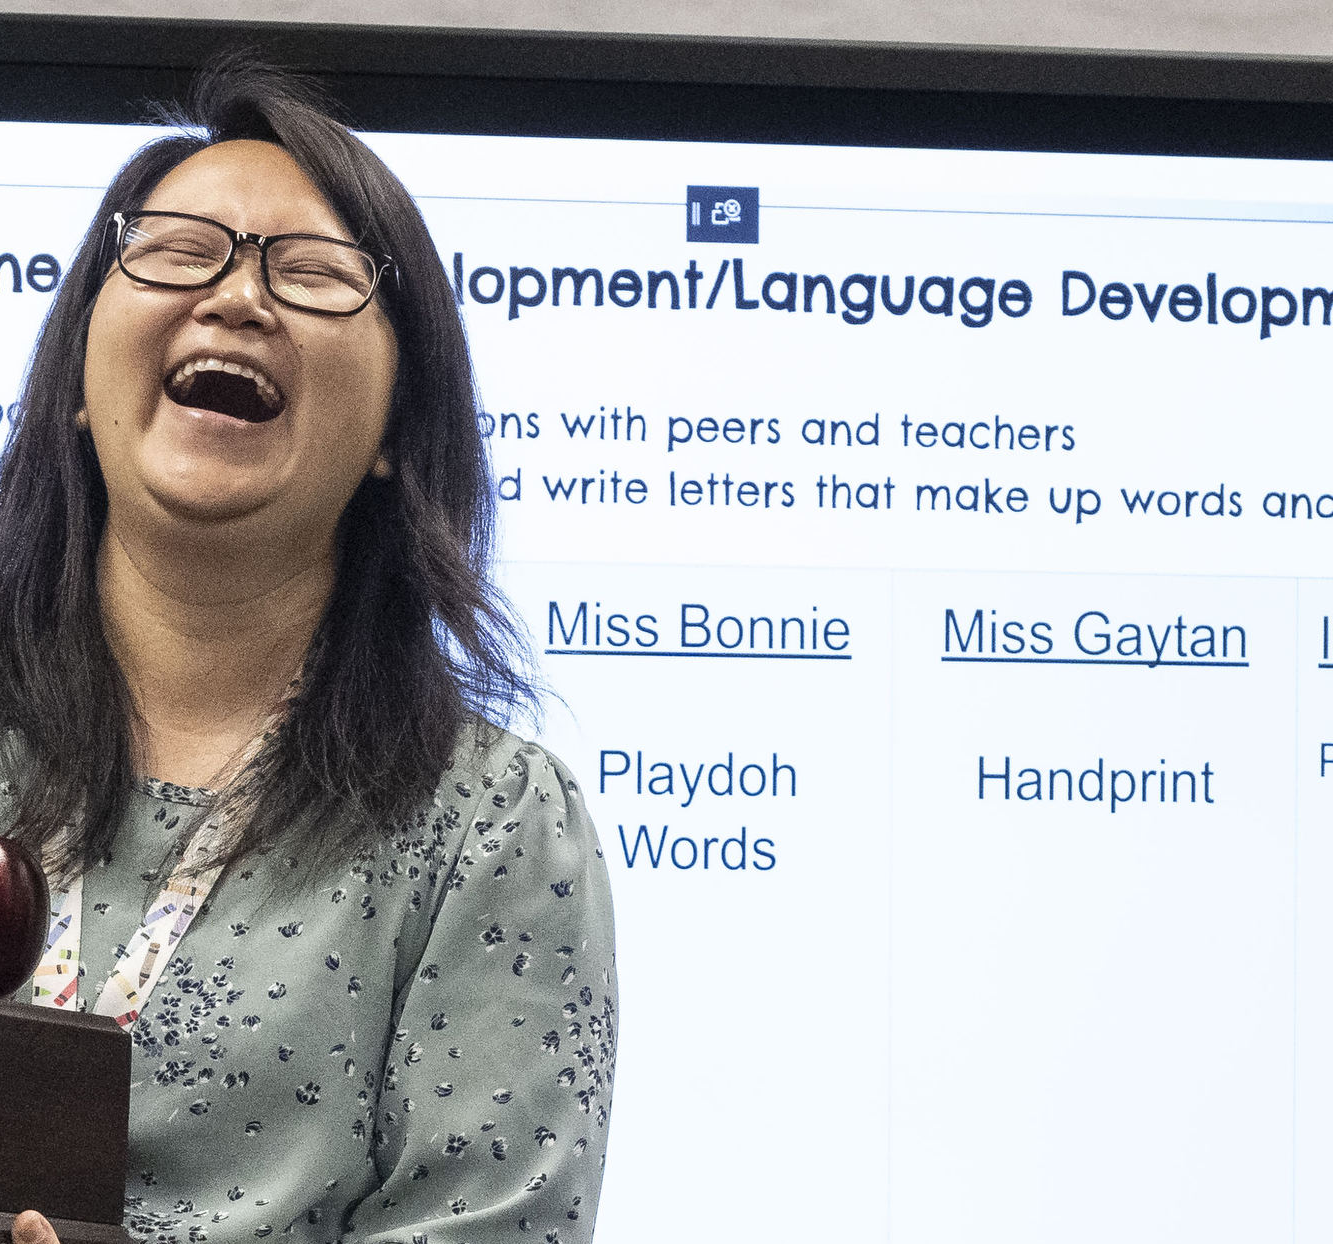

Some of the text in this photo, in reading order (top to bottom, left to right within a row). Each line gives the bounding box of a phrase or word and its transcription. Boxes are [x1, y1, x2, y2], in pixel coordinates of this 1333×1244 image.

[454, 252, 1033, 328] lopment/Language
[561, 405, 647, 442] with
[668, 415, 781, 452] peers
[801, 412, 881, 448] and
[902, 413, 1075, 452] teachers
[543, 469, 648, 505] write
[669, 471, 795, 509] letters
[817, 475, 895, 510] that
[916, 478, 1029, 514] make
[1050, 484, 1102, 523] up
[1121, 482, 1243, 519] words
[547, 601, 851, 654] Miss Bonnie
[943, 609, 1248, 669] Miss Gaytan
[600, 750, 797, 807] Playdoh
[978, 755, 1215, 813] Handprint
[618, 824, 776, 870] Words
